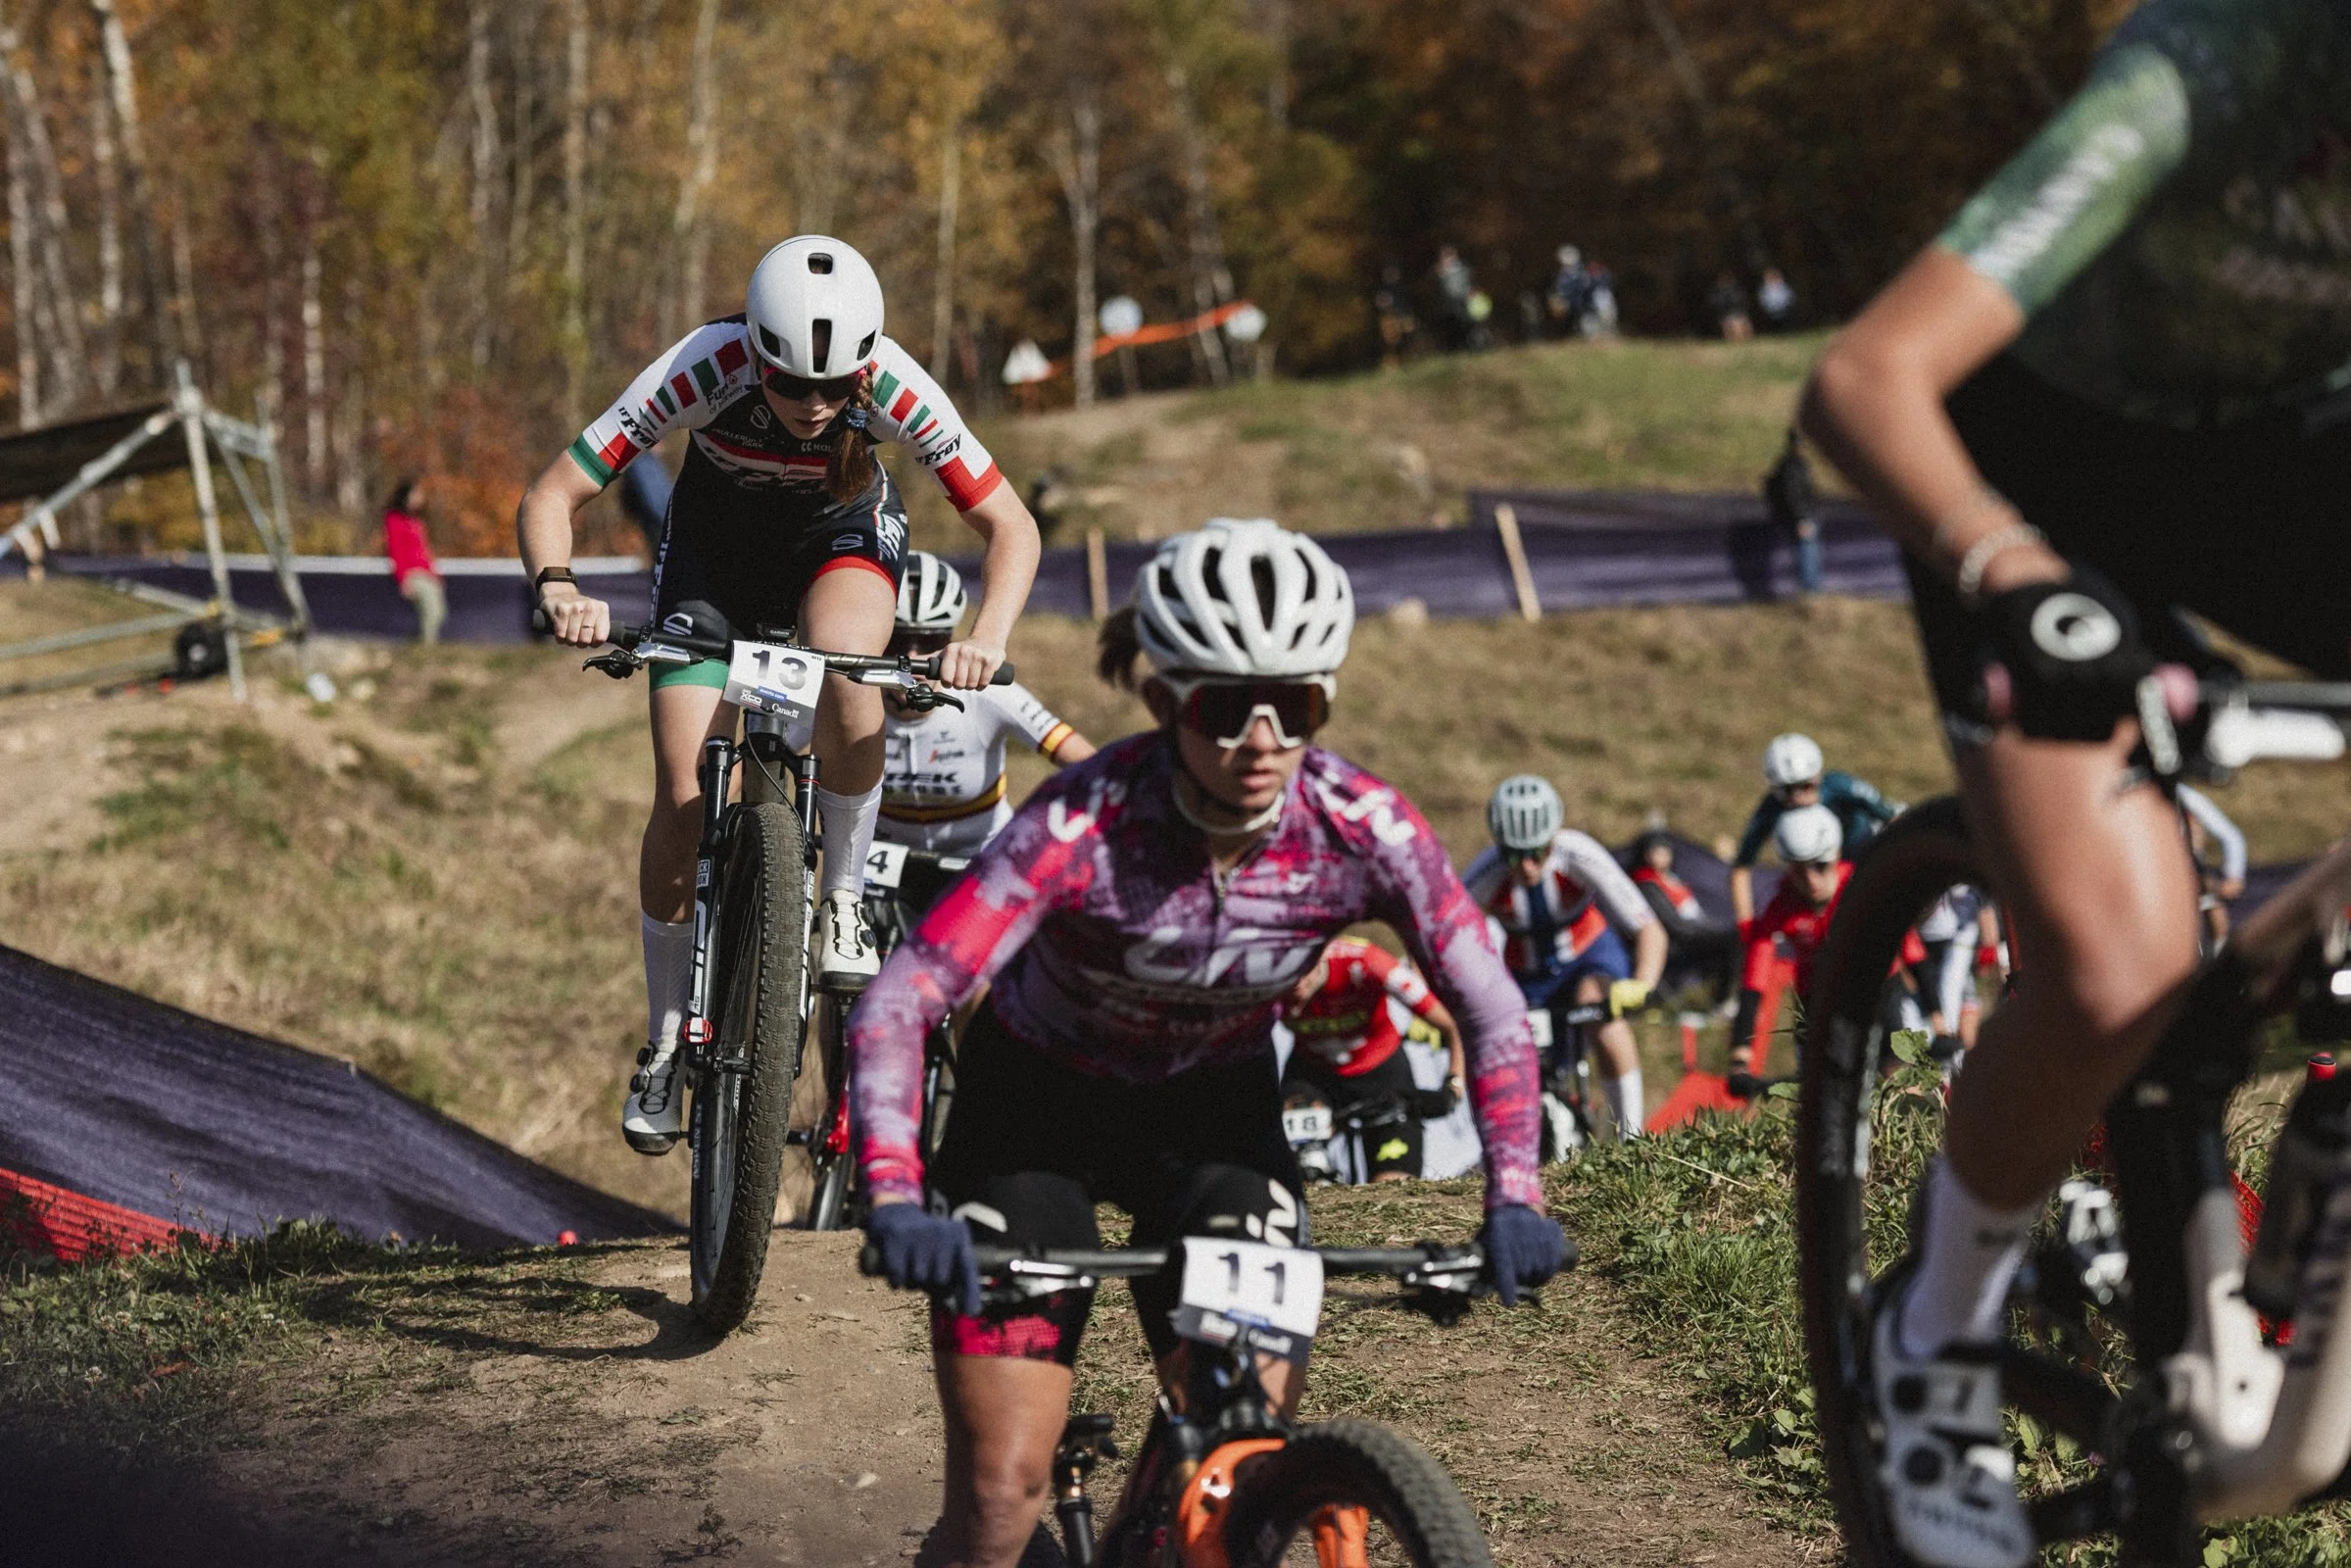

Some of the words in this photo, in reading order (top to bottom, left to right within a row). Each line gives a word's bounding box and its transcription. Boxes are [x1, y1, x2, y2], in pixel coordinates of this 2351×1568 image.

[753, 650, 808, 690] 13
[740, 692, 762, 705] XCO
[772, 703, 799, 718] Canada
[866, 851, 888, 874] 4
[1218, 1252, 1285, 1305] 11
